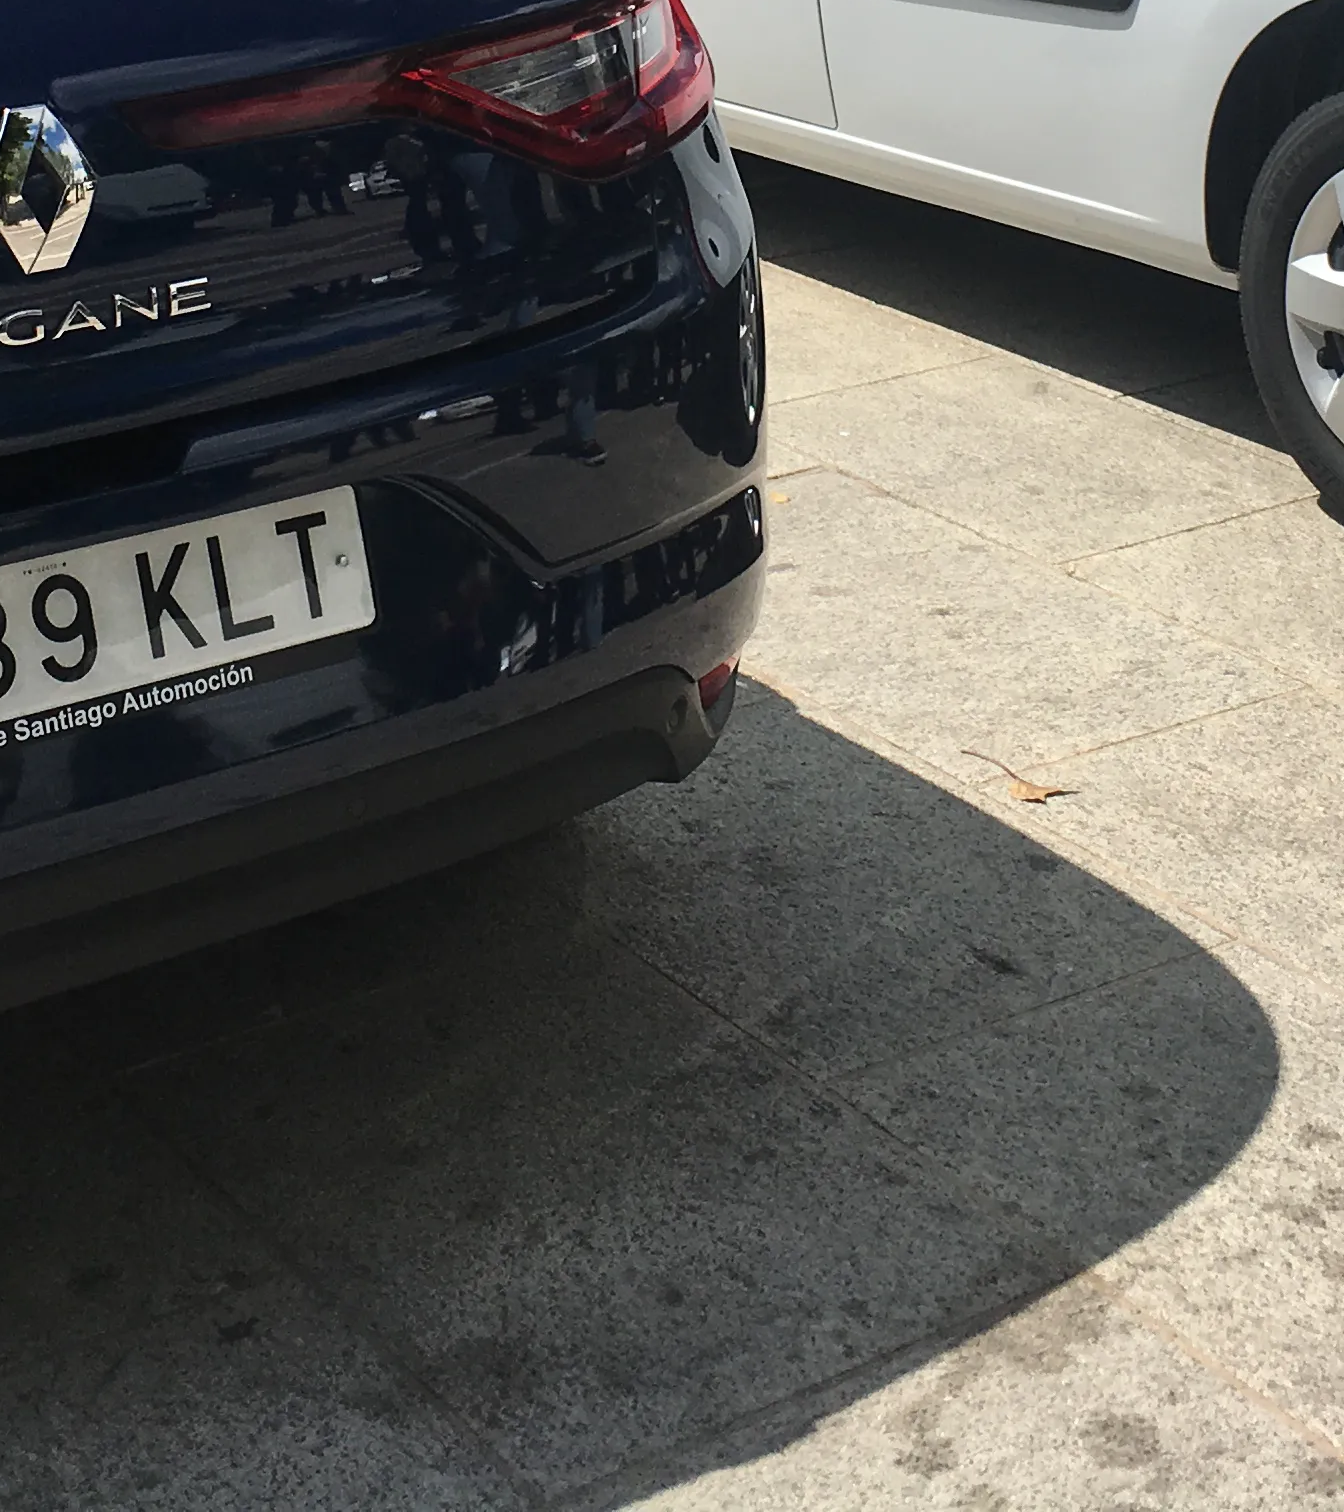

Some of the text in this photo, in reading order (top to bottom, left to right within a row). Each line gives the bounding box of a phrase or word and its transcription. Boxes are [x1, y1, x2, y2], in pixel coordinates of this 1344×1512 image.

[135, 511, 327, 658] KLT
[13, 700, 118, 743] Santiago
[122, 664, 254, 716] Automoción
